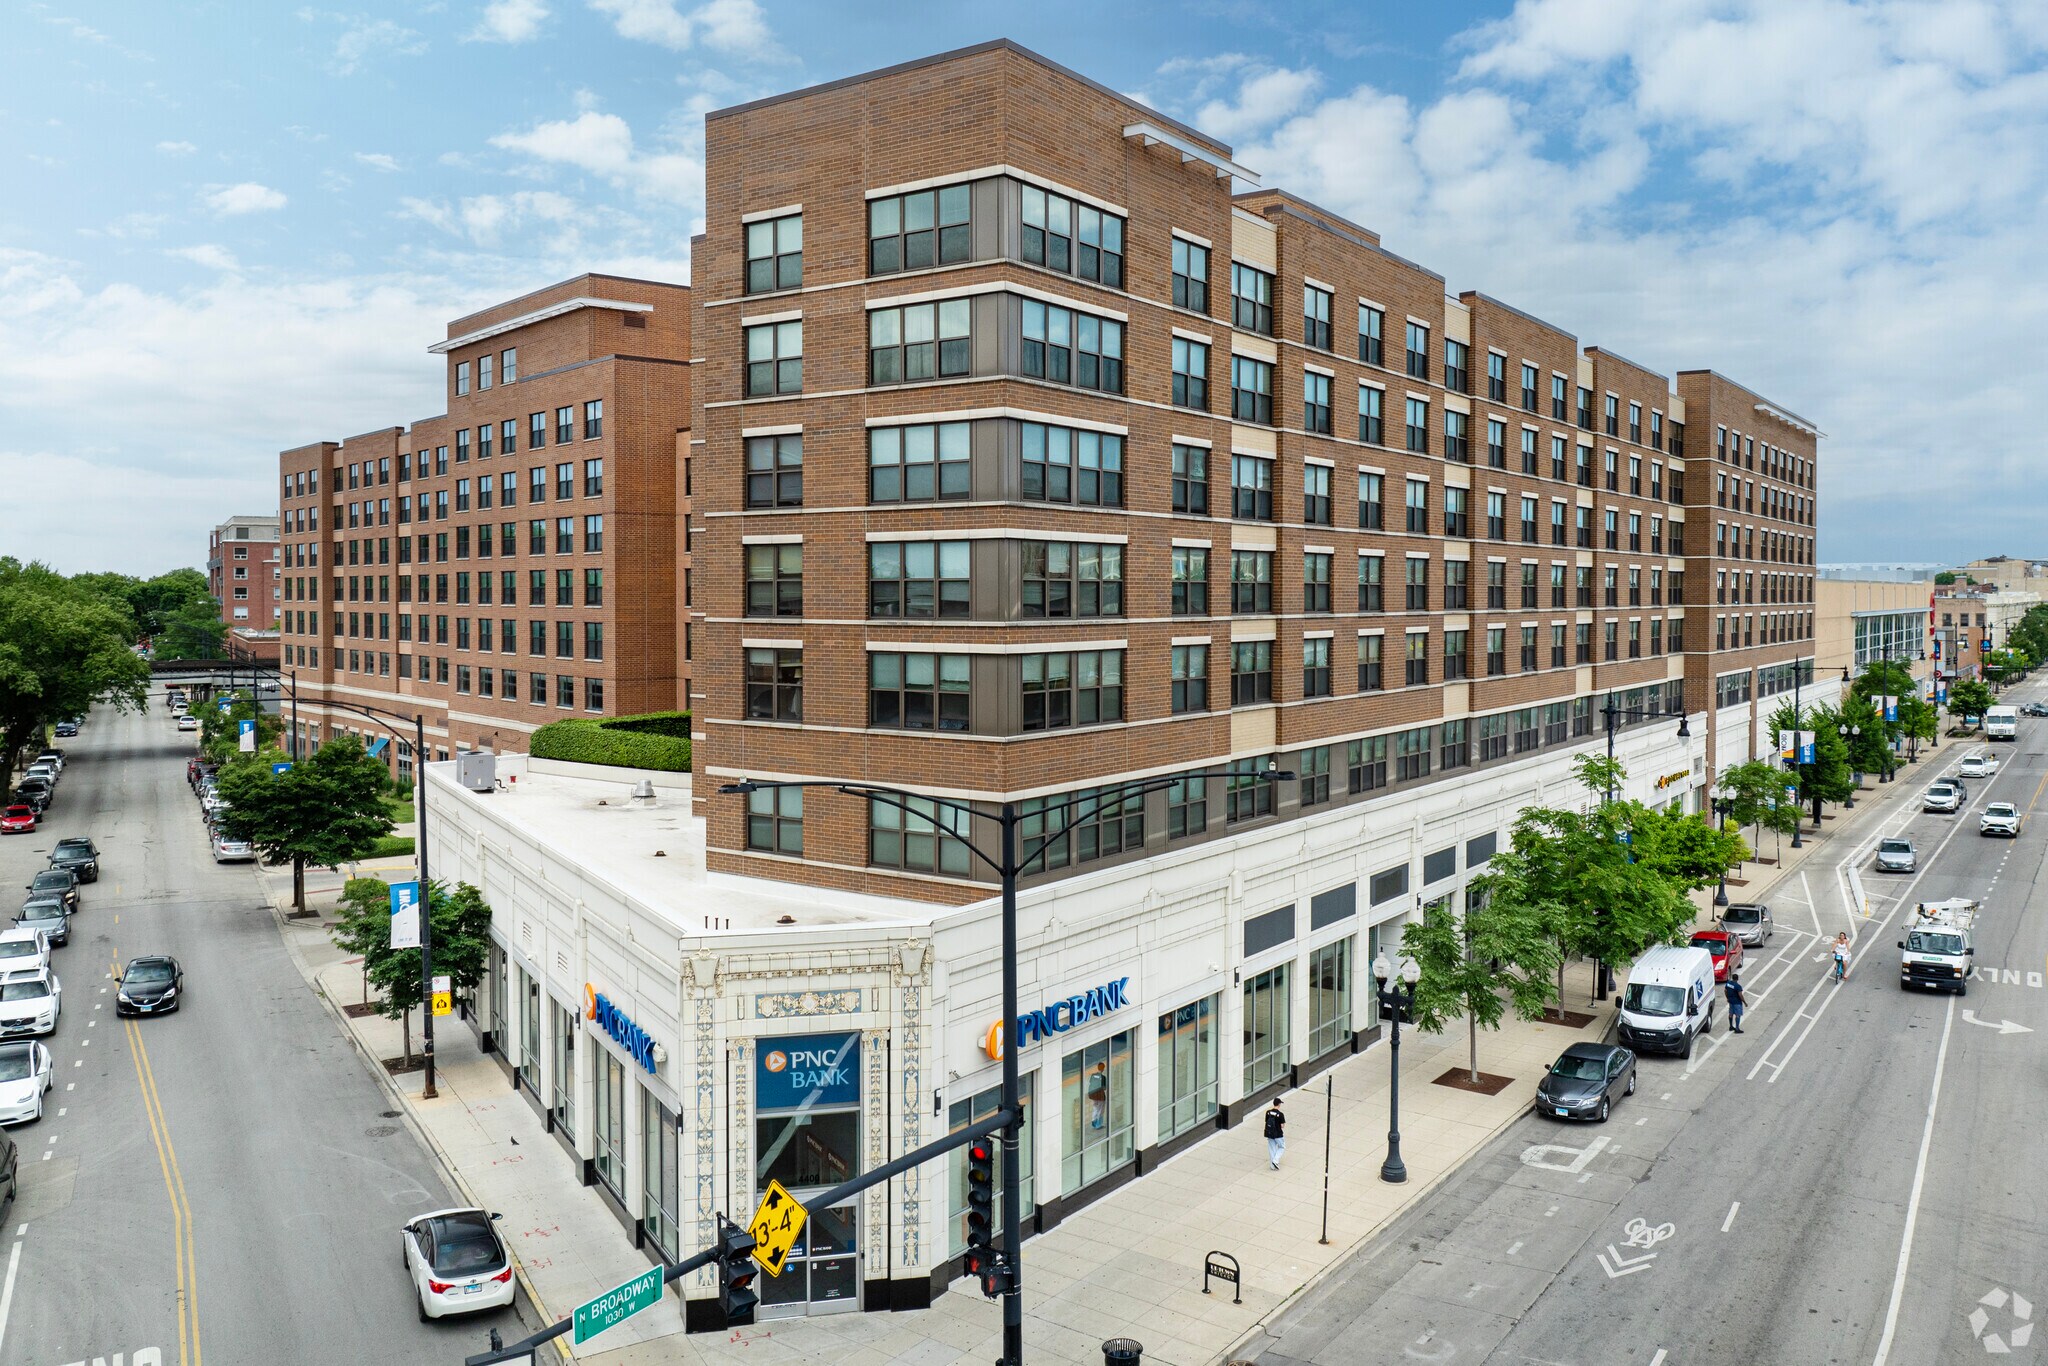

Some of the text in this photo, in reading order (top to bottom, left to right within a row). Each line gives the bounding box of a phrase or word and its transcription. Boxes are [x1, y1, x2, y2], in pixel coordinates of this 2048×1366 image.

[1966, 966, 2043, 988] ONLY
[790, 1049, 837, 1069] PNC
[790, 1068, 849, 1088] BANK
[579, 1273, 657, 1323] N BROADWAY
[628, 1301, 636, 1312] W
